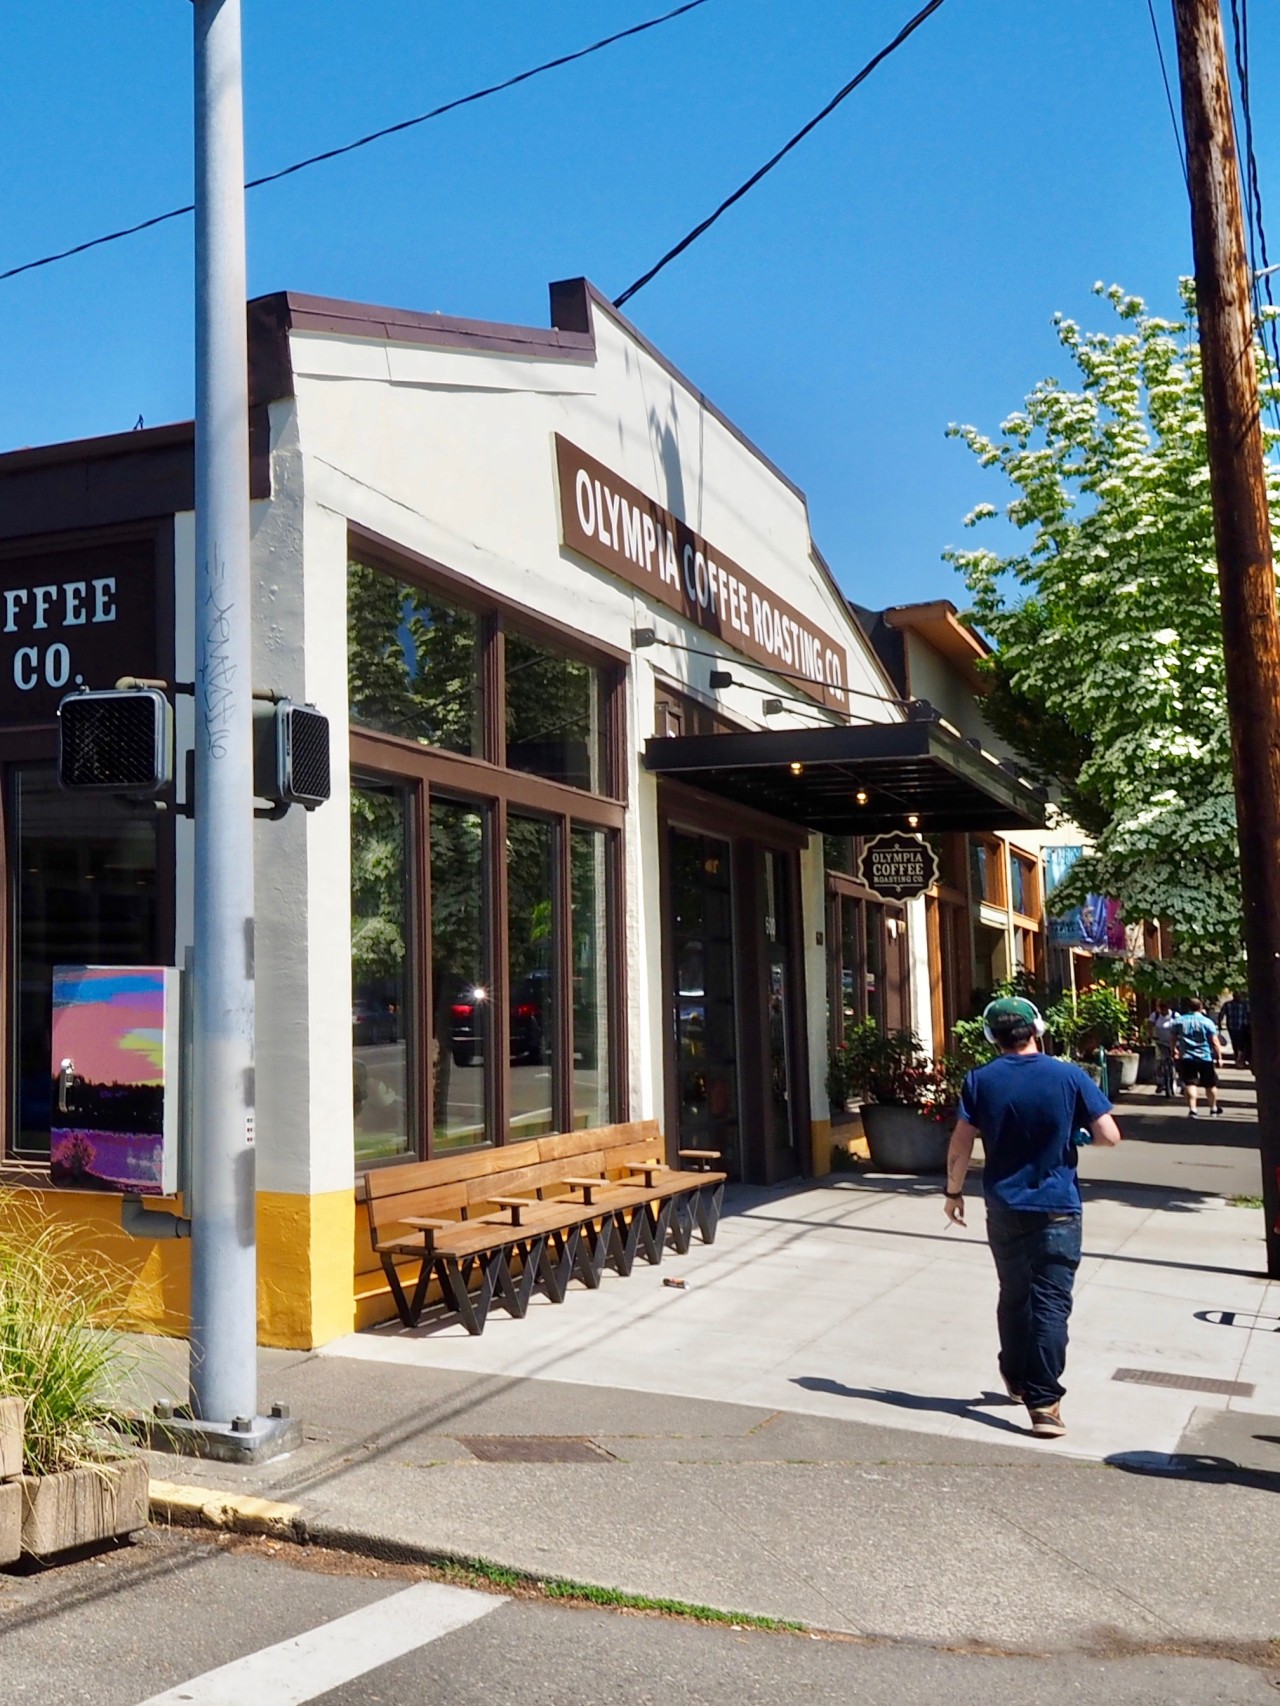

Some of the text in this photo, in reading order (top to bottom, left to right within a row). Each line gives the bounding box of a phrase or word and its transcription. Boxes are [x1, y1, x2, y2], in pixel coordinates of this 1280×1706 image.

[576, 469, 681, 592] OLYMPIA
[684, 543, 750, 636] COFFEE
[752, 591, 823, 682] ROASTING
[14, 643, 83, 690] CO.
[872, 852, 923, 863] OLYMPIA
[872, 863, 924, 876] COFFEE
